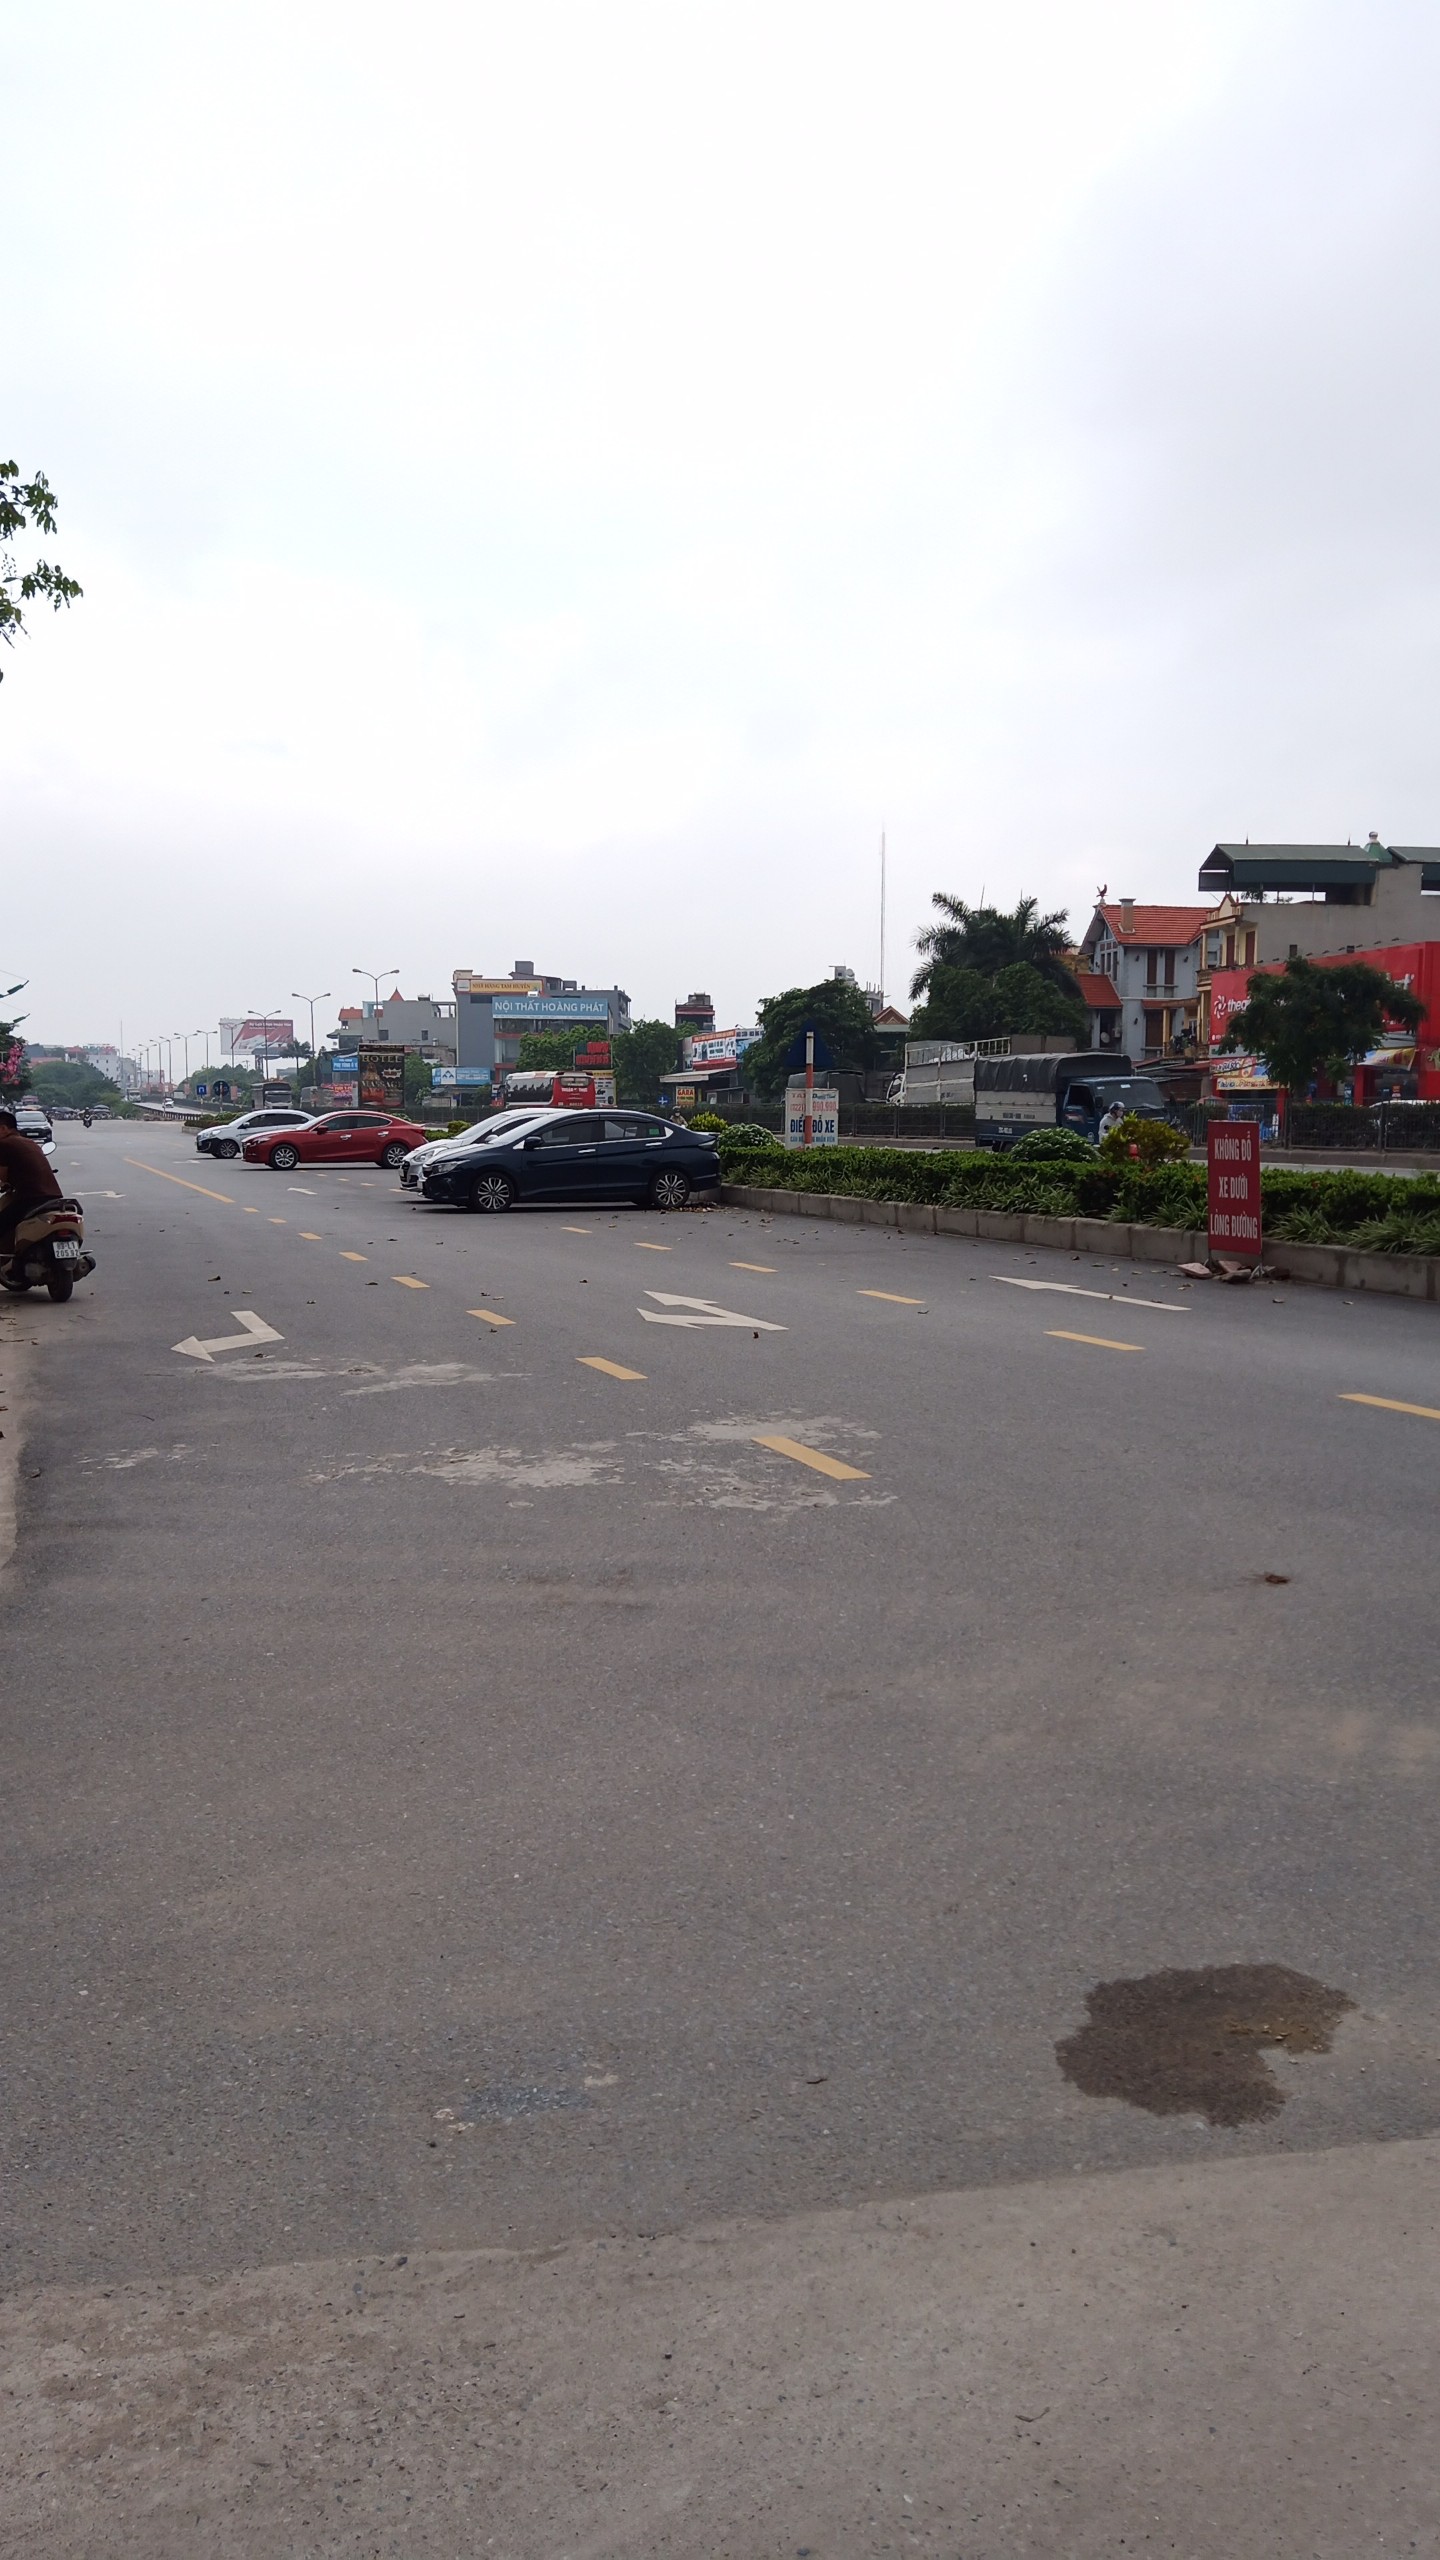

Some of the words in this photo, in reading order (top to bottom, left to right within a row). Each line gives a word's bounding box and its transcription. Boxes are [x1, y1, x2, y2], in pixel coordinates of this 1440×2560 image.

[495, 1000, 513, 1013] NỘI
[515, 999, 539, 1011] THẤT
[541, 1001, 578, 1012] HOÀNG
[580, 1001, 604, 1012] PHÁT
[362, 1055, 402, 1063] HOTEL
[790, 1113, 806, 1133] ĐIỂ
[824, 1119, 835, 1133] XE
[1214, 1134, 1240, 1160] KHÔNG
[1218, 1176, 1228, 1198] XE
[1230, 1173, 1248, 1200] DƯỚI
[1210, 1209, 1230, 1236] LÒNG
[1231, 1211, 1258, 1239] ĐƯỜNG
